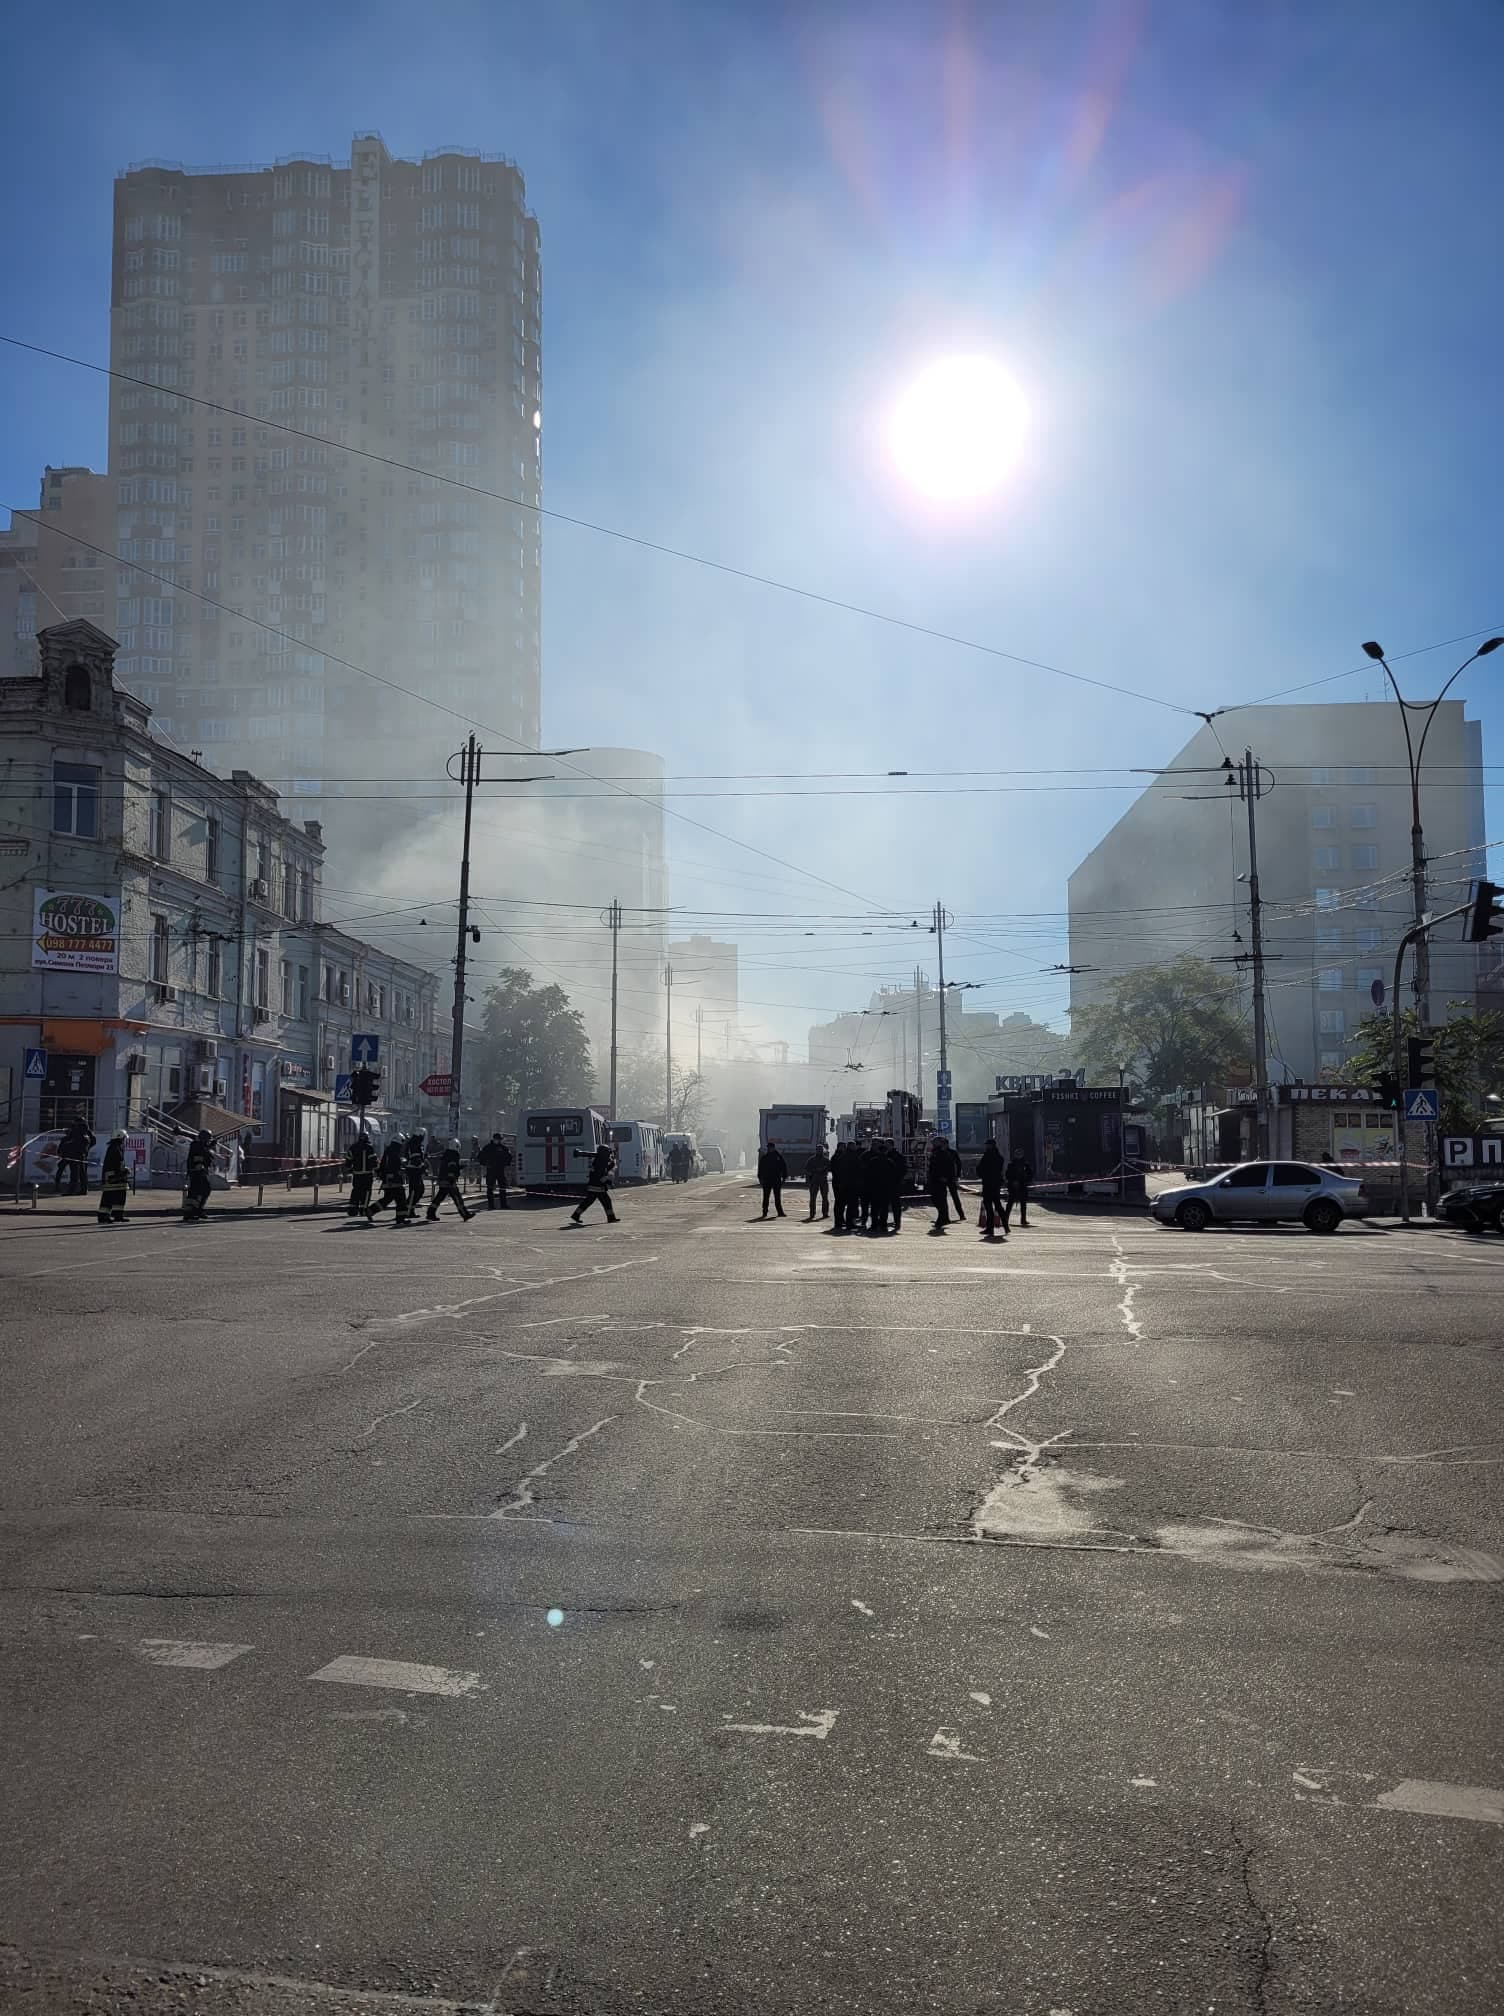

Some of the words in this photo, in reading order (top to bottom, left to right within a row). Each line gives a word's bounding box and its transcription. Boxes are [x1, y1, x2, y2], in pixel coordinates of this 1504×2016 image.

[56, 896, 98, 916] 777
[41, 911, 113, 935] HOSTEL
[46, 937, 65, 949] 098
[68, 939, 87, 949] 777
[88, 940, 113, 951] 4477
[1055, 1067, 1086, 1088] 24
[1089, 1090, 1117, 1100] COFFEE
[1481, 1139, 1504, 1164] П
